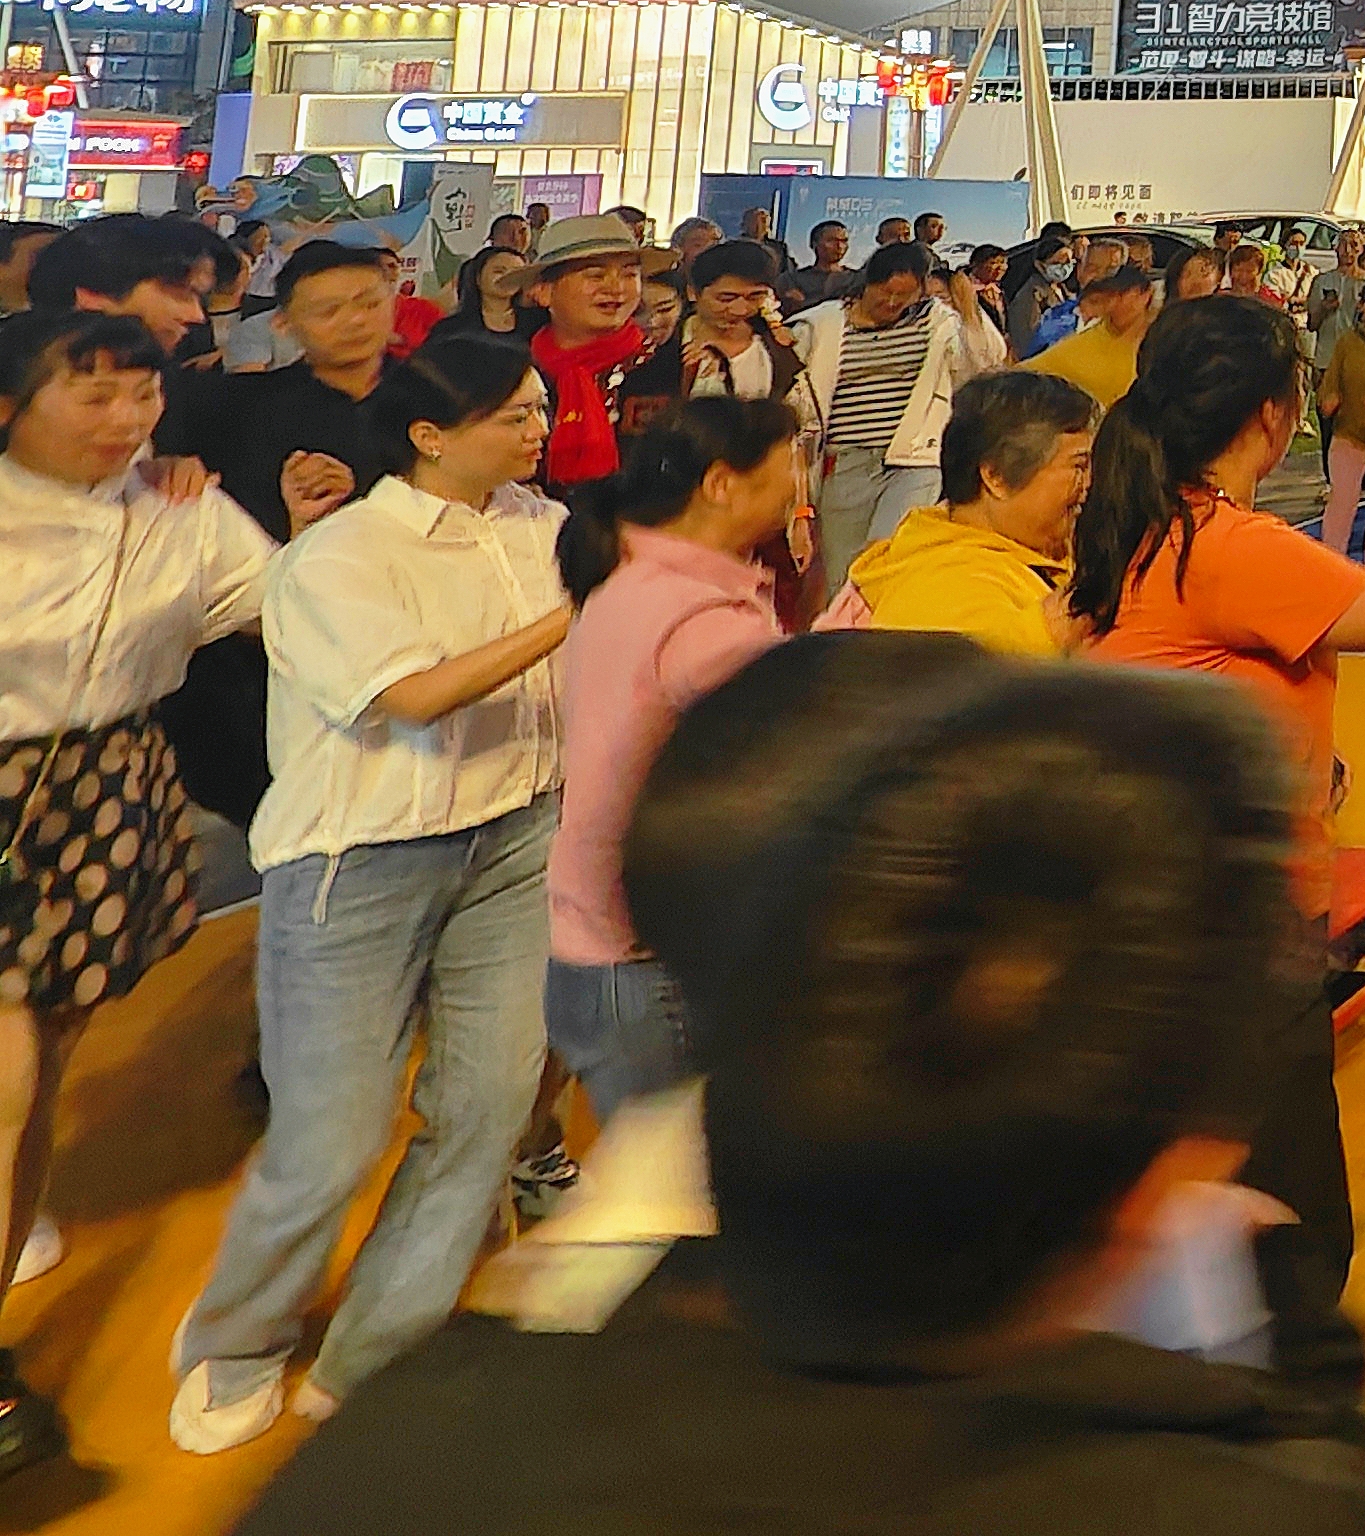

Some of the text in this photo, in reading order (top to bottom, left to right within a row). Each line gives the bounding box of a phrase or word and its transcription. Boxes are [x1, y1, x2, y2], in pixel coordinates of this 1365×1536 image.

[1135, 2, 1333, 34] 31智力竞技馆
[443, 102, 524, 125] 中国黄金
